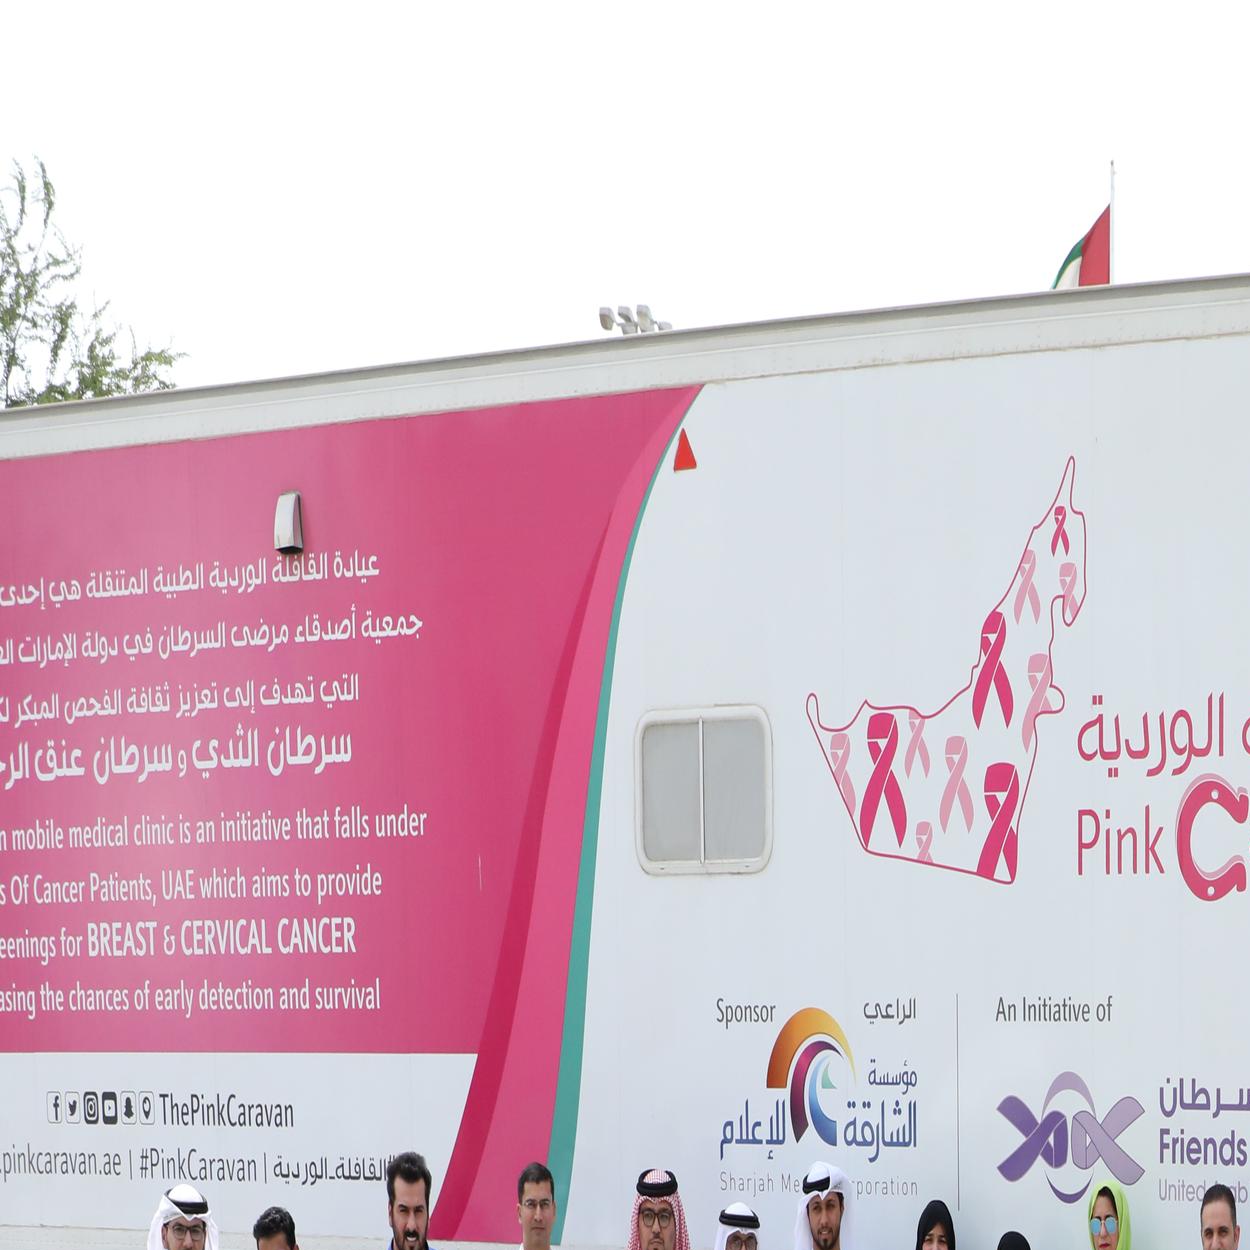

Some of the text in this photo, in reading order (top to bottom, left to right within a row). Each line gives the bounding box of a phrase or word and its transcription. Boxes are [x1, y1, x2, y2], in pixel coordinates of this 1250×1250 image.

[86, 568, 148, 597] المتنقلة
[154, 563, 203, 598] الطبية
[209, 558, 266, 593] الوردية
[271, 551, 328, 583] القافلة
[334, 550, 379, 583] عيادة
[49, 580, 81, 608] هي
[231, 619, 288, 652] مرضى
[295, 604, 355, 642] أصدقاء
[362, 611, 422, 644] جمعية
[18, 633, 76, 668] الإمارات
[82, 632, 118, 664] دولة
[123, 627, 152, 661] في
[159, 622, 226, 659] السرطان
[127, 682, 170, 713] ثقافة
[176, 682, 218, 718] تعزيز
[224, 680, 255, 713] إلى
[260, 676, 315, 705] تهدف
[319, 673, 359, 705] التي
[15, 694, 59, 728] المبكر
[64, 689, 121, 724] الفحص
[192, 723, 258, 778] الثدي
[268, 726, 351, 776] سرطان
[1078, 692, 1224, 777] الوردية
[35, 740, 85, 781] عنق
[93, 736, 172, 784] سرطان
[178, 750, 186, 777] و
[12, 819, 63, 850] mobile
[69, 816, 128, 847] medical
[134, 815, 174, 845] clinic
[180, 814, 191, 843] is
[196, 821, 214, 843] an
[221, 811, 290, 841] initiative
[296, 808, 329, 839] that
[334, 806, 369, 838] falls
[376, 804, 427, 837] under
[1078, 805, 1164, 875] Pink
[11, 875, 28, 904] Of
[34, 875, 85, 904] Cancer
[90, 872, 156, 906] Patients,
[162, 870, 194, 900] UAE
[200, 867, 246, 898] which
[253, 867, 289, 897] aims
[295, 868, 311, 896] to
[318, 863, 382, 904] provide
[60, 927, 82, 956] for
[88, 921, 157, 956] BREAST
[164, 925, 176, 955] &
[181, 919, 272, 955] CERVICAL
[278, 917, 356, 953] CANCER
[40, 982, 64, 1011] the
[69, 981, 129, 1010] chances
[134, 980, 150, 1010] of
[155, 980, 193, 1018] early
[199, 980, 273, 1009] detection
[280, 978, 309, 1009] and
[316, 978, 380, 1009] survival
[717, 998, 775, 1029] Sponsor
[864, 998, 915, 1025] الراعي
[996, 996, 1112, 1022] An Initiative of
[868, 1059, 917, 1095] مؤسسة
[159, 1093, 293, 1127] ThePinkCaravan
[720, 1099, 916, 1163] الشارقة للإعلام
[1160, 1128, 1247, 1166] Friends
[140, 1148, 256, 1181] #PinkCaravan
[720, 1171, 773, 1197] Sharjah
[1158, 1178, 1206, 1202] United
